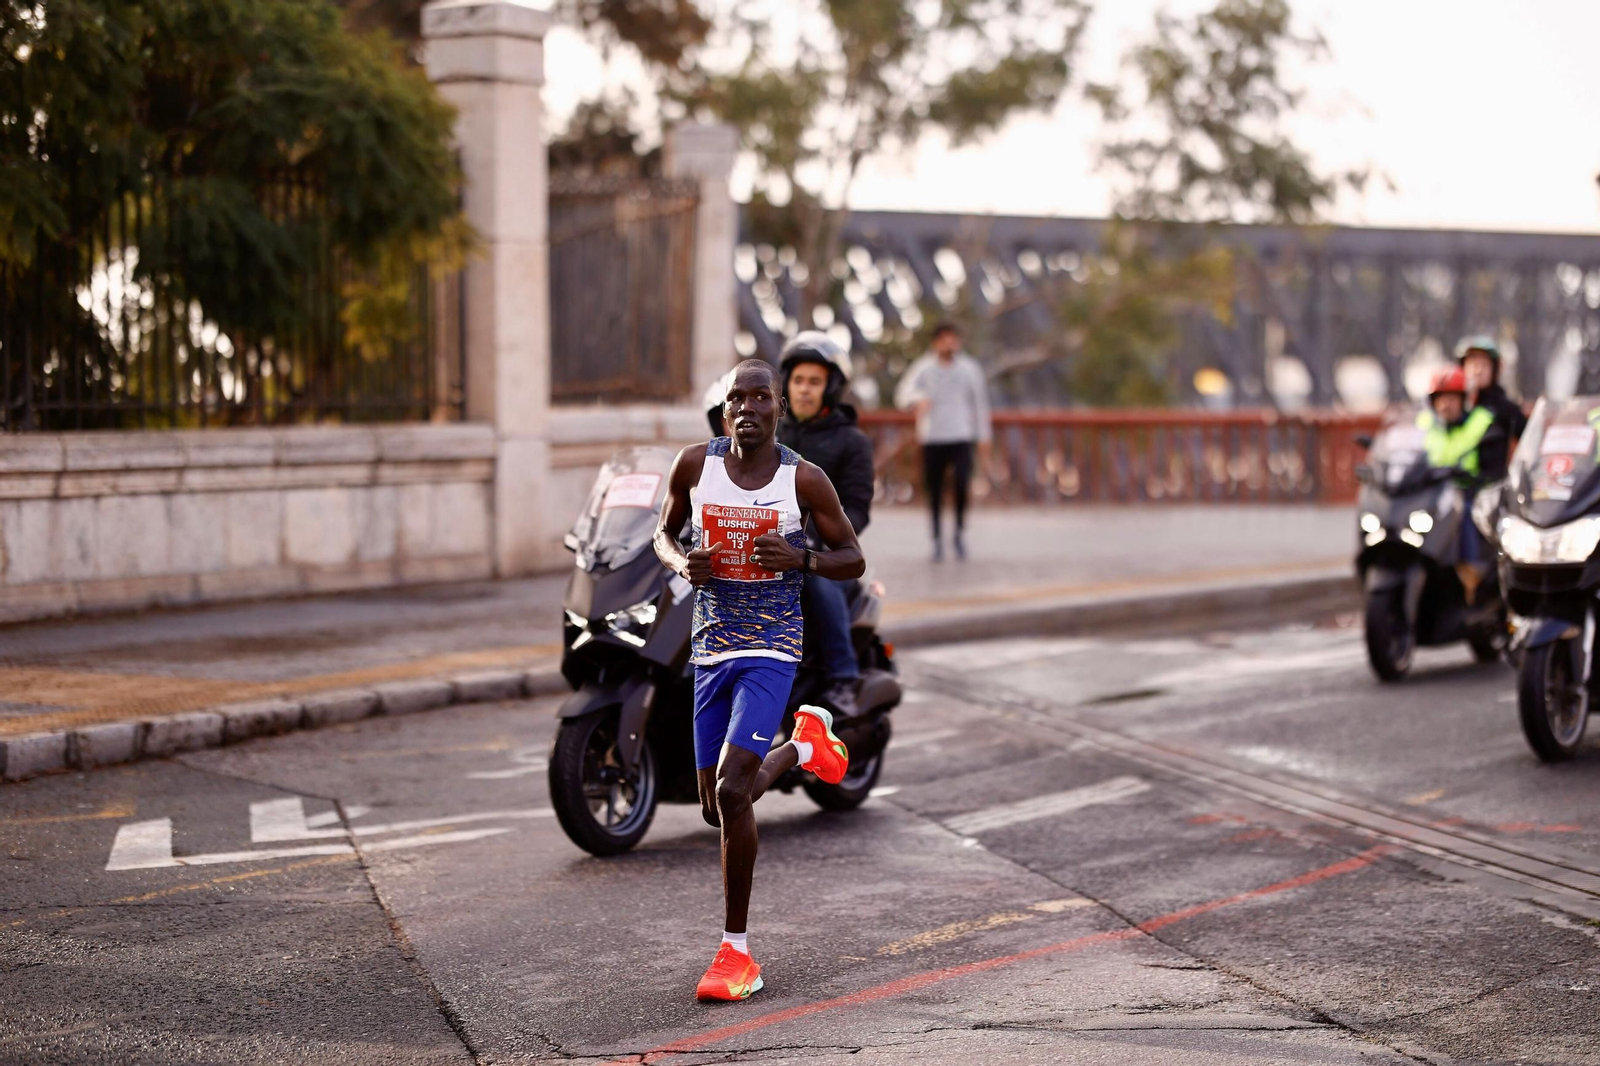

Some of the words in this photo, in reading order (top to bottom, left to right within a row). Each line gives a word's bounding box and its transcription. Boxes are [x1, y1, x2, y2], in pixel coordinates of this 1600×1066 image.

[721, 507, 773, 520] GENERALI
[717, 518, 759, 529] BUSHEN-
[727, 531, 749, 541] DICH
[732, 540, 744, 549] 13
